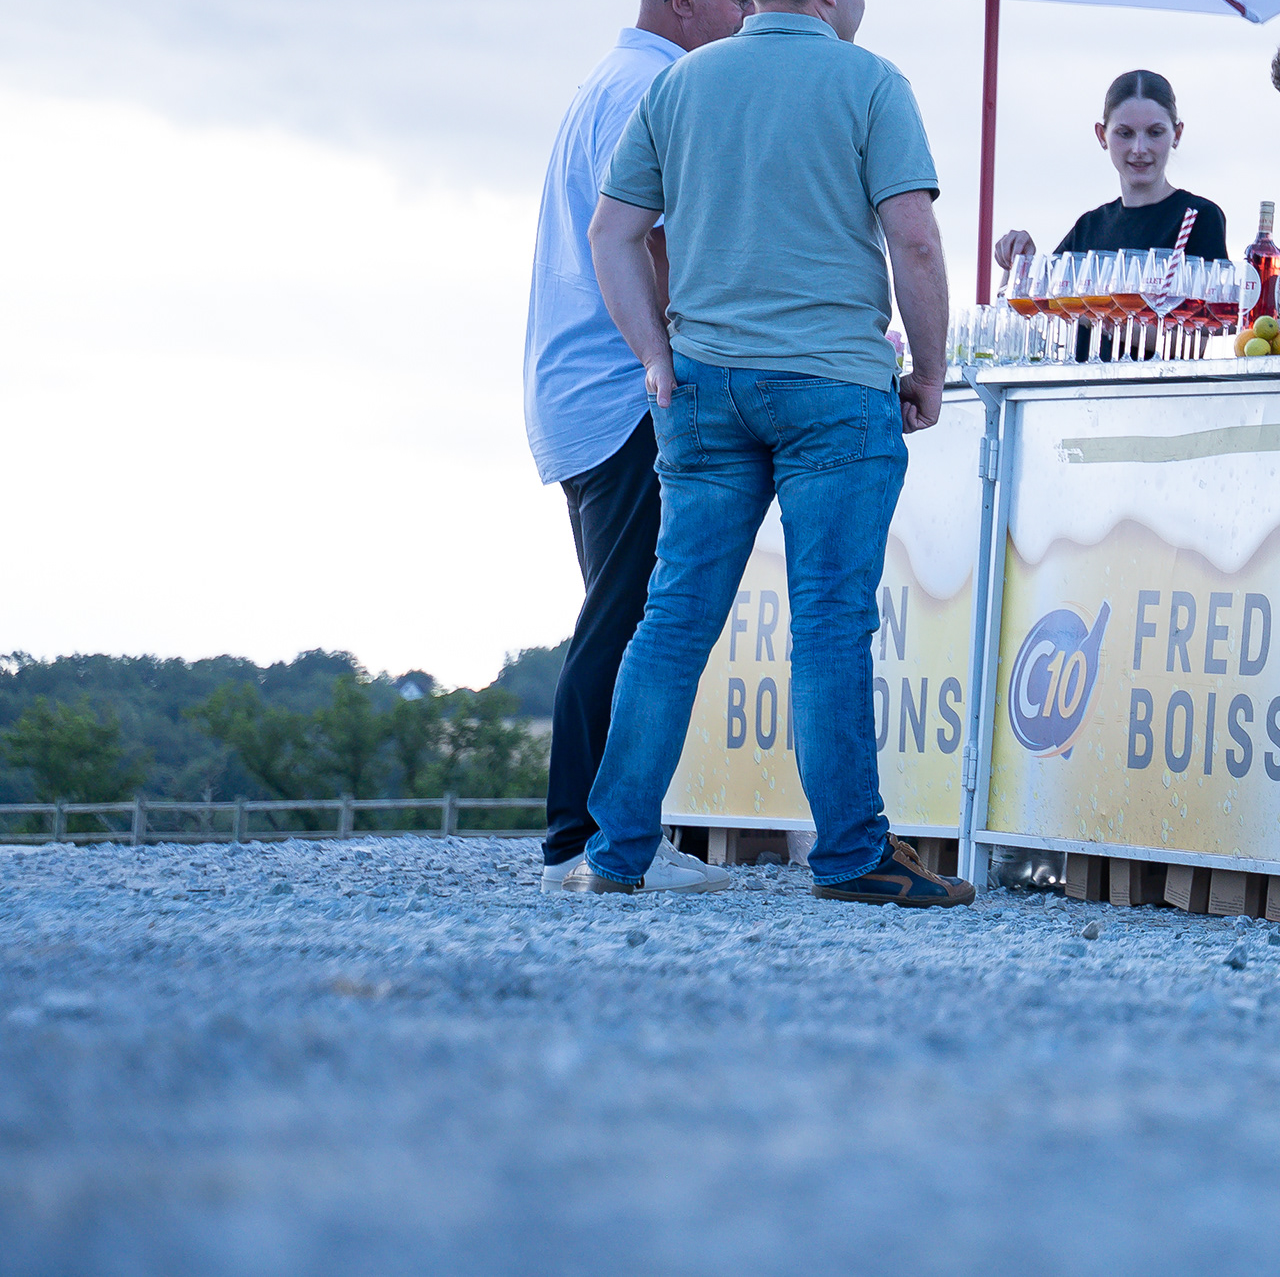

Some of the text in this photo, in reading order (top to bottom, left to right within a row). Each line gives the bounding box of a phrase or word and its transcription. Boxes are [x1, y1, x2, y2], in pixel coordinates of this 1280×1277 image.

[729, 586, 909, 662] FRN
[727, 676, 963, 755] BOIONS
[1018, 639, 1087, 719] C10
